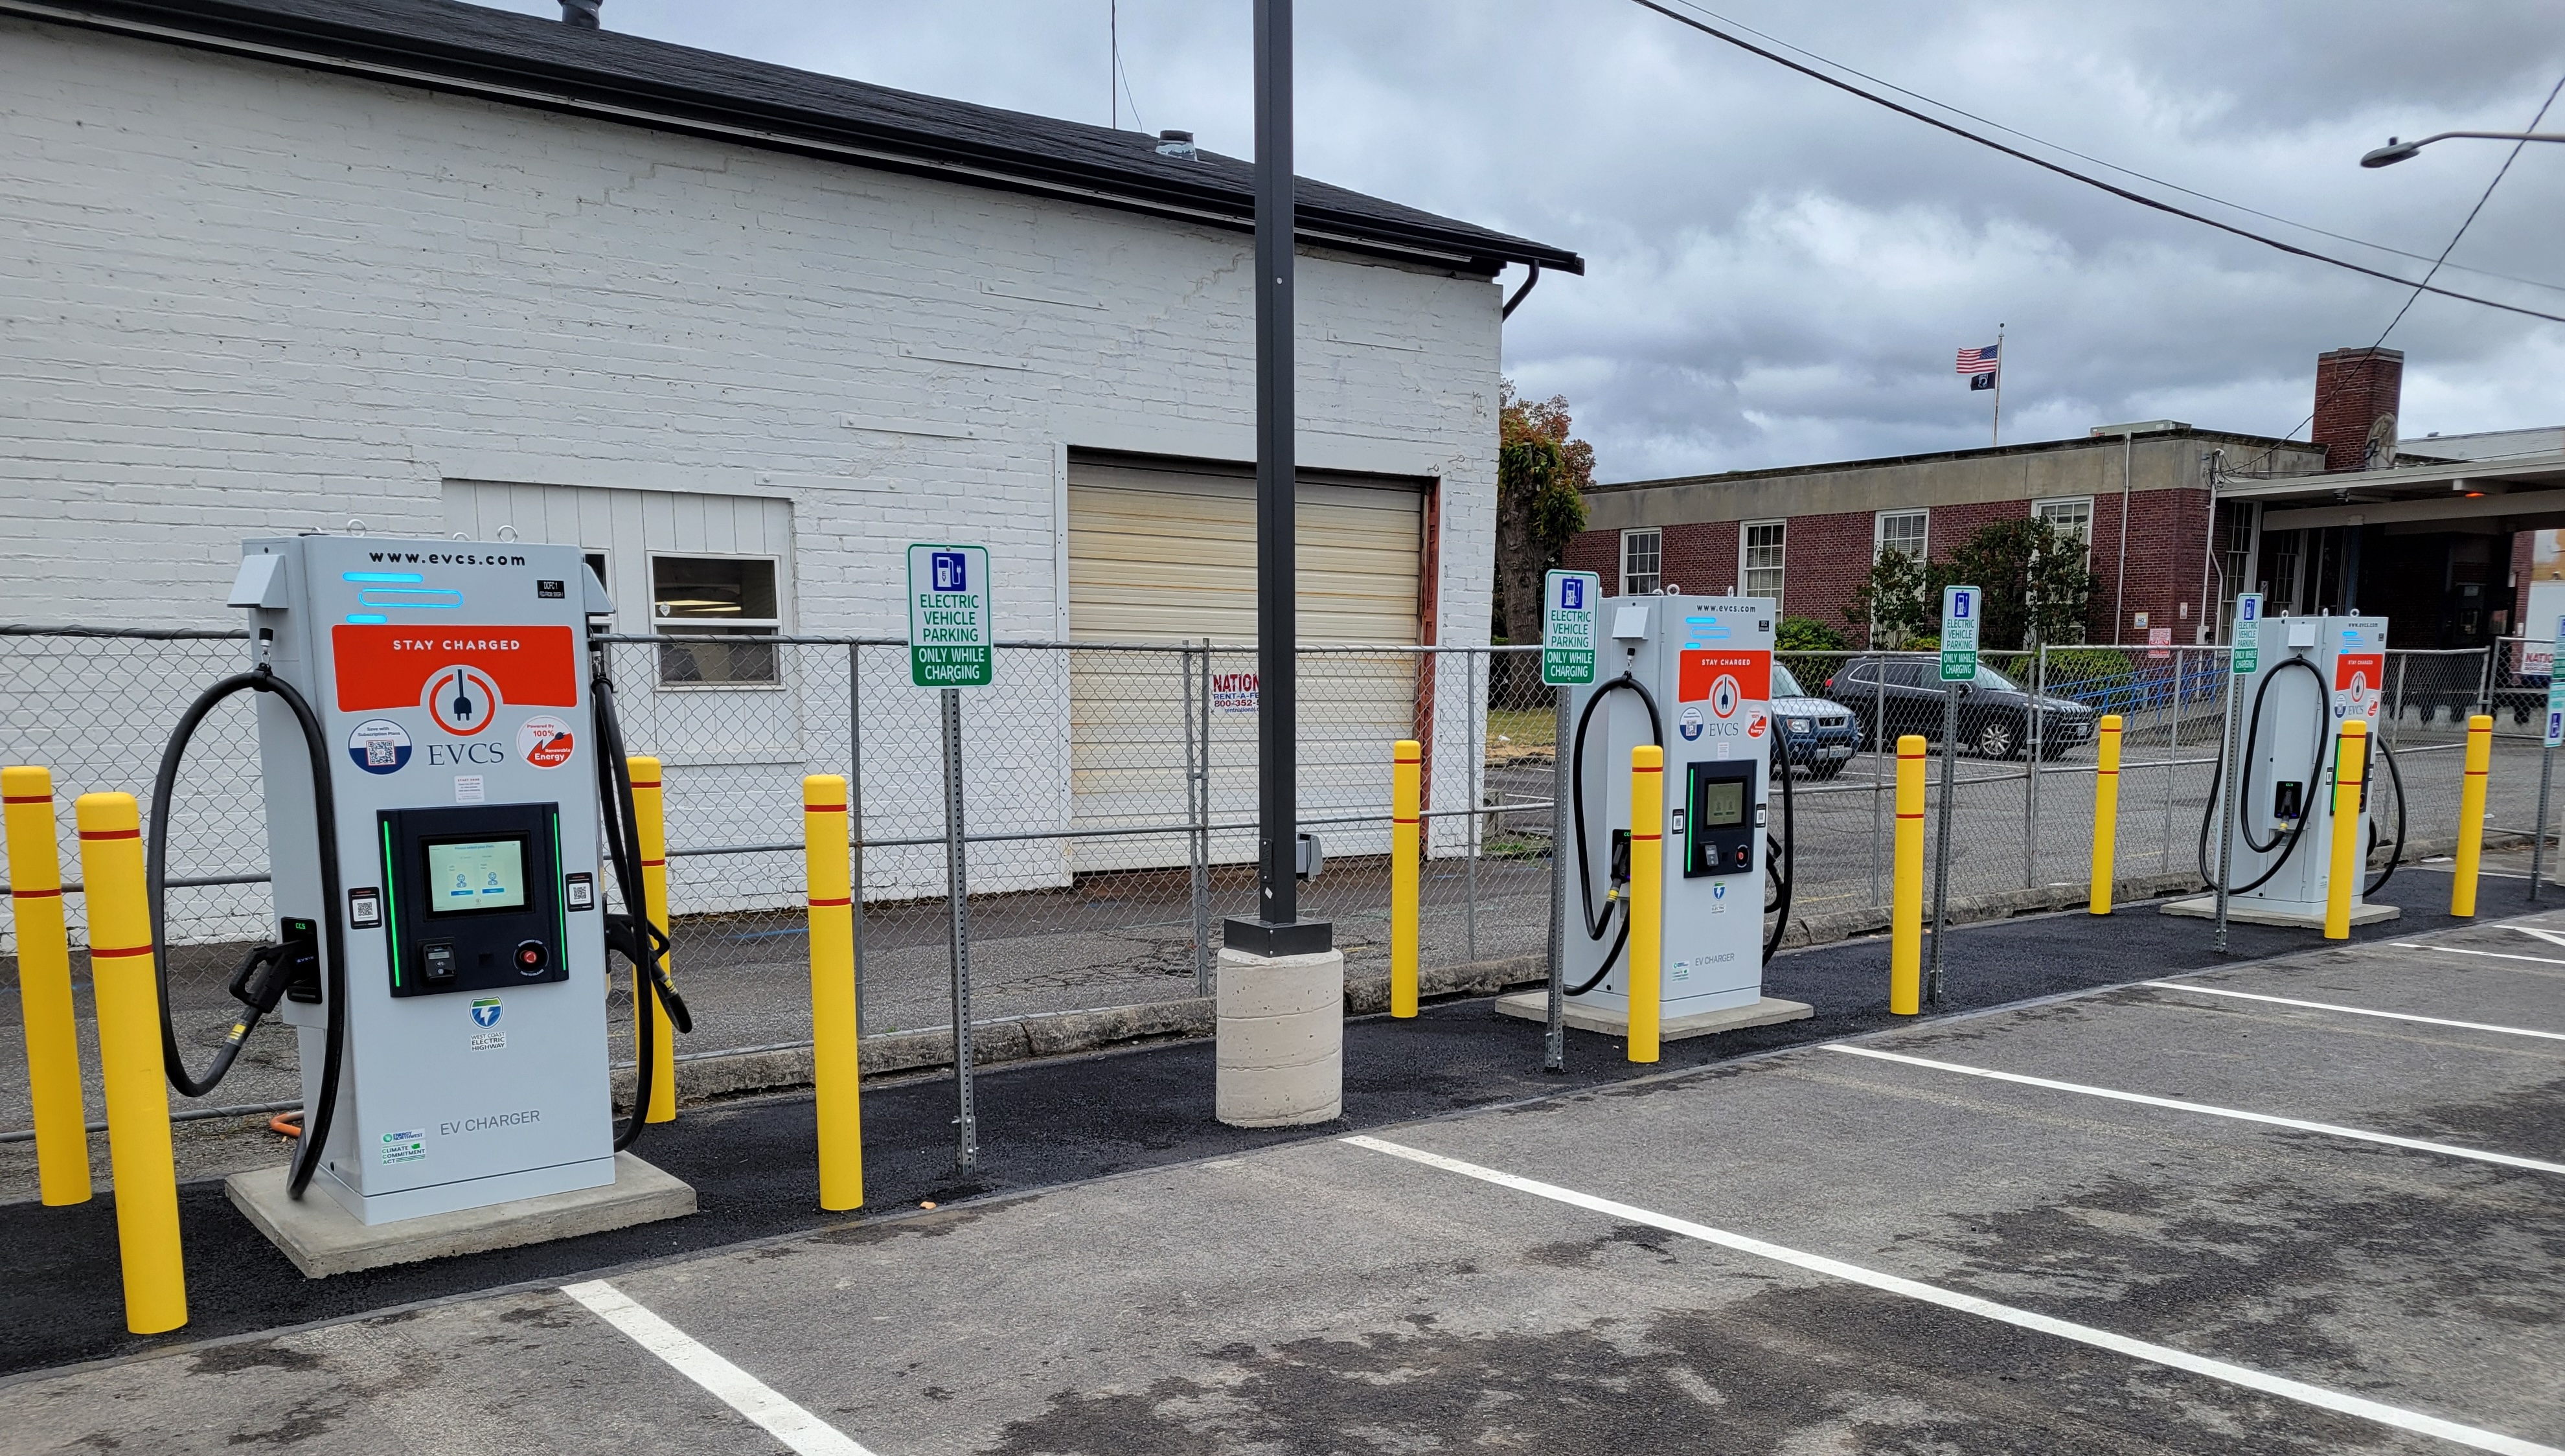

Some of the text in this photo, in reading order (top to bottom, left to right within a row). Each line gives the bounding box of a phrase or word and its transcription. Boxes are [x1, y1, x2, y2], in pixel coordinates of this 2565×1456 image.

[369, 552, 526, 566] www.evcs.com
[920, 594, 979, 608] ELECTRIC
[1697, 604, 1756, 613] www.evcs.com
[923, 611, 976, 625] VEHICLE
[1551, 610, 1591, 622] ELECTRIC
[1947, 619, 1975, 628] ELECTRIC
[2238, 621, 2258, 630] ELECTRIC
[1553, 623, 1588, 635] VEHICLE
[923, 628, 979, 642] PARKING
[1948, 630, 1972, 639] VEHICLE
[2239, 630, 2256, 639] VEHICLE
[393, 640, 520, 650] STAY CHARGED
[1551, 636, 1589, 648] PARKING
[1946, 640, 1972, 649] PARKING
[918, 648, 985, 663] ONLY WHILE
[1547, 651, 1593, 664] ONLY WHILE
[1943, 653, 1975, 663] ONLY WHILE
[2235, 650, 2257, 659] ONLY WHILE
[1945, 664, 1972, 674] CHARGING
[2235, 660, 2255, 668] CHARGING
[925, 665, 980, 679] CHARGING
[1550, 665, 1588, 677] CHARGING
[2348, 705, 2364, 715] EVCS
[1709, 722, 1739, 737] EVCS
[426, 742, 505, 766] EVCS
[534, 753, 565, 761] Energy
[1695, 957, 1704, 966] EV
[1704, 953, 1735, 965] CHARGER
[472, 1036, 505, 1045] ELECTRIC
[472, 1042, 505, 1051] HIGHWAY
[440, 1109, 540, 1135] EV CHARGER
[382, 1145, 409, 1154] CLIMATE
[382, 1148, 426, 1159] COMMITMENT
